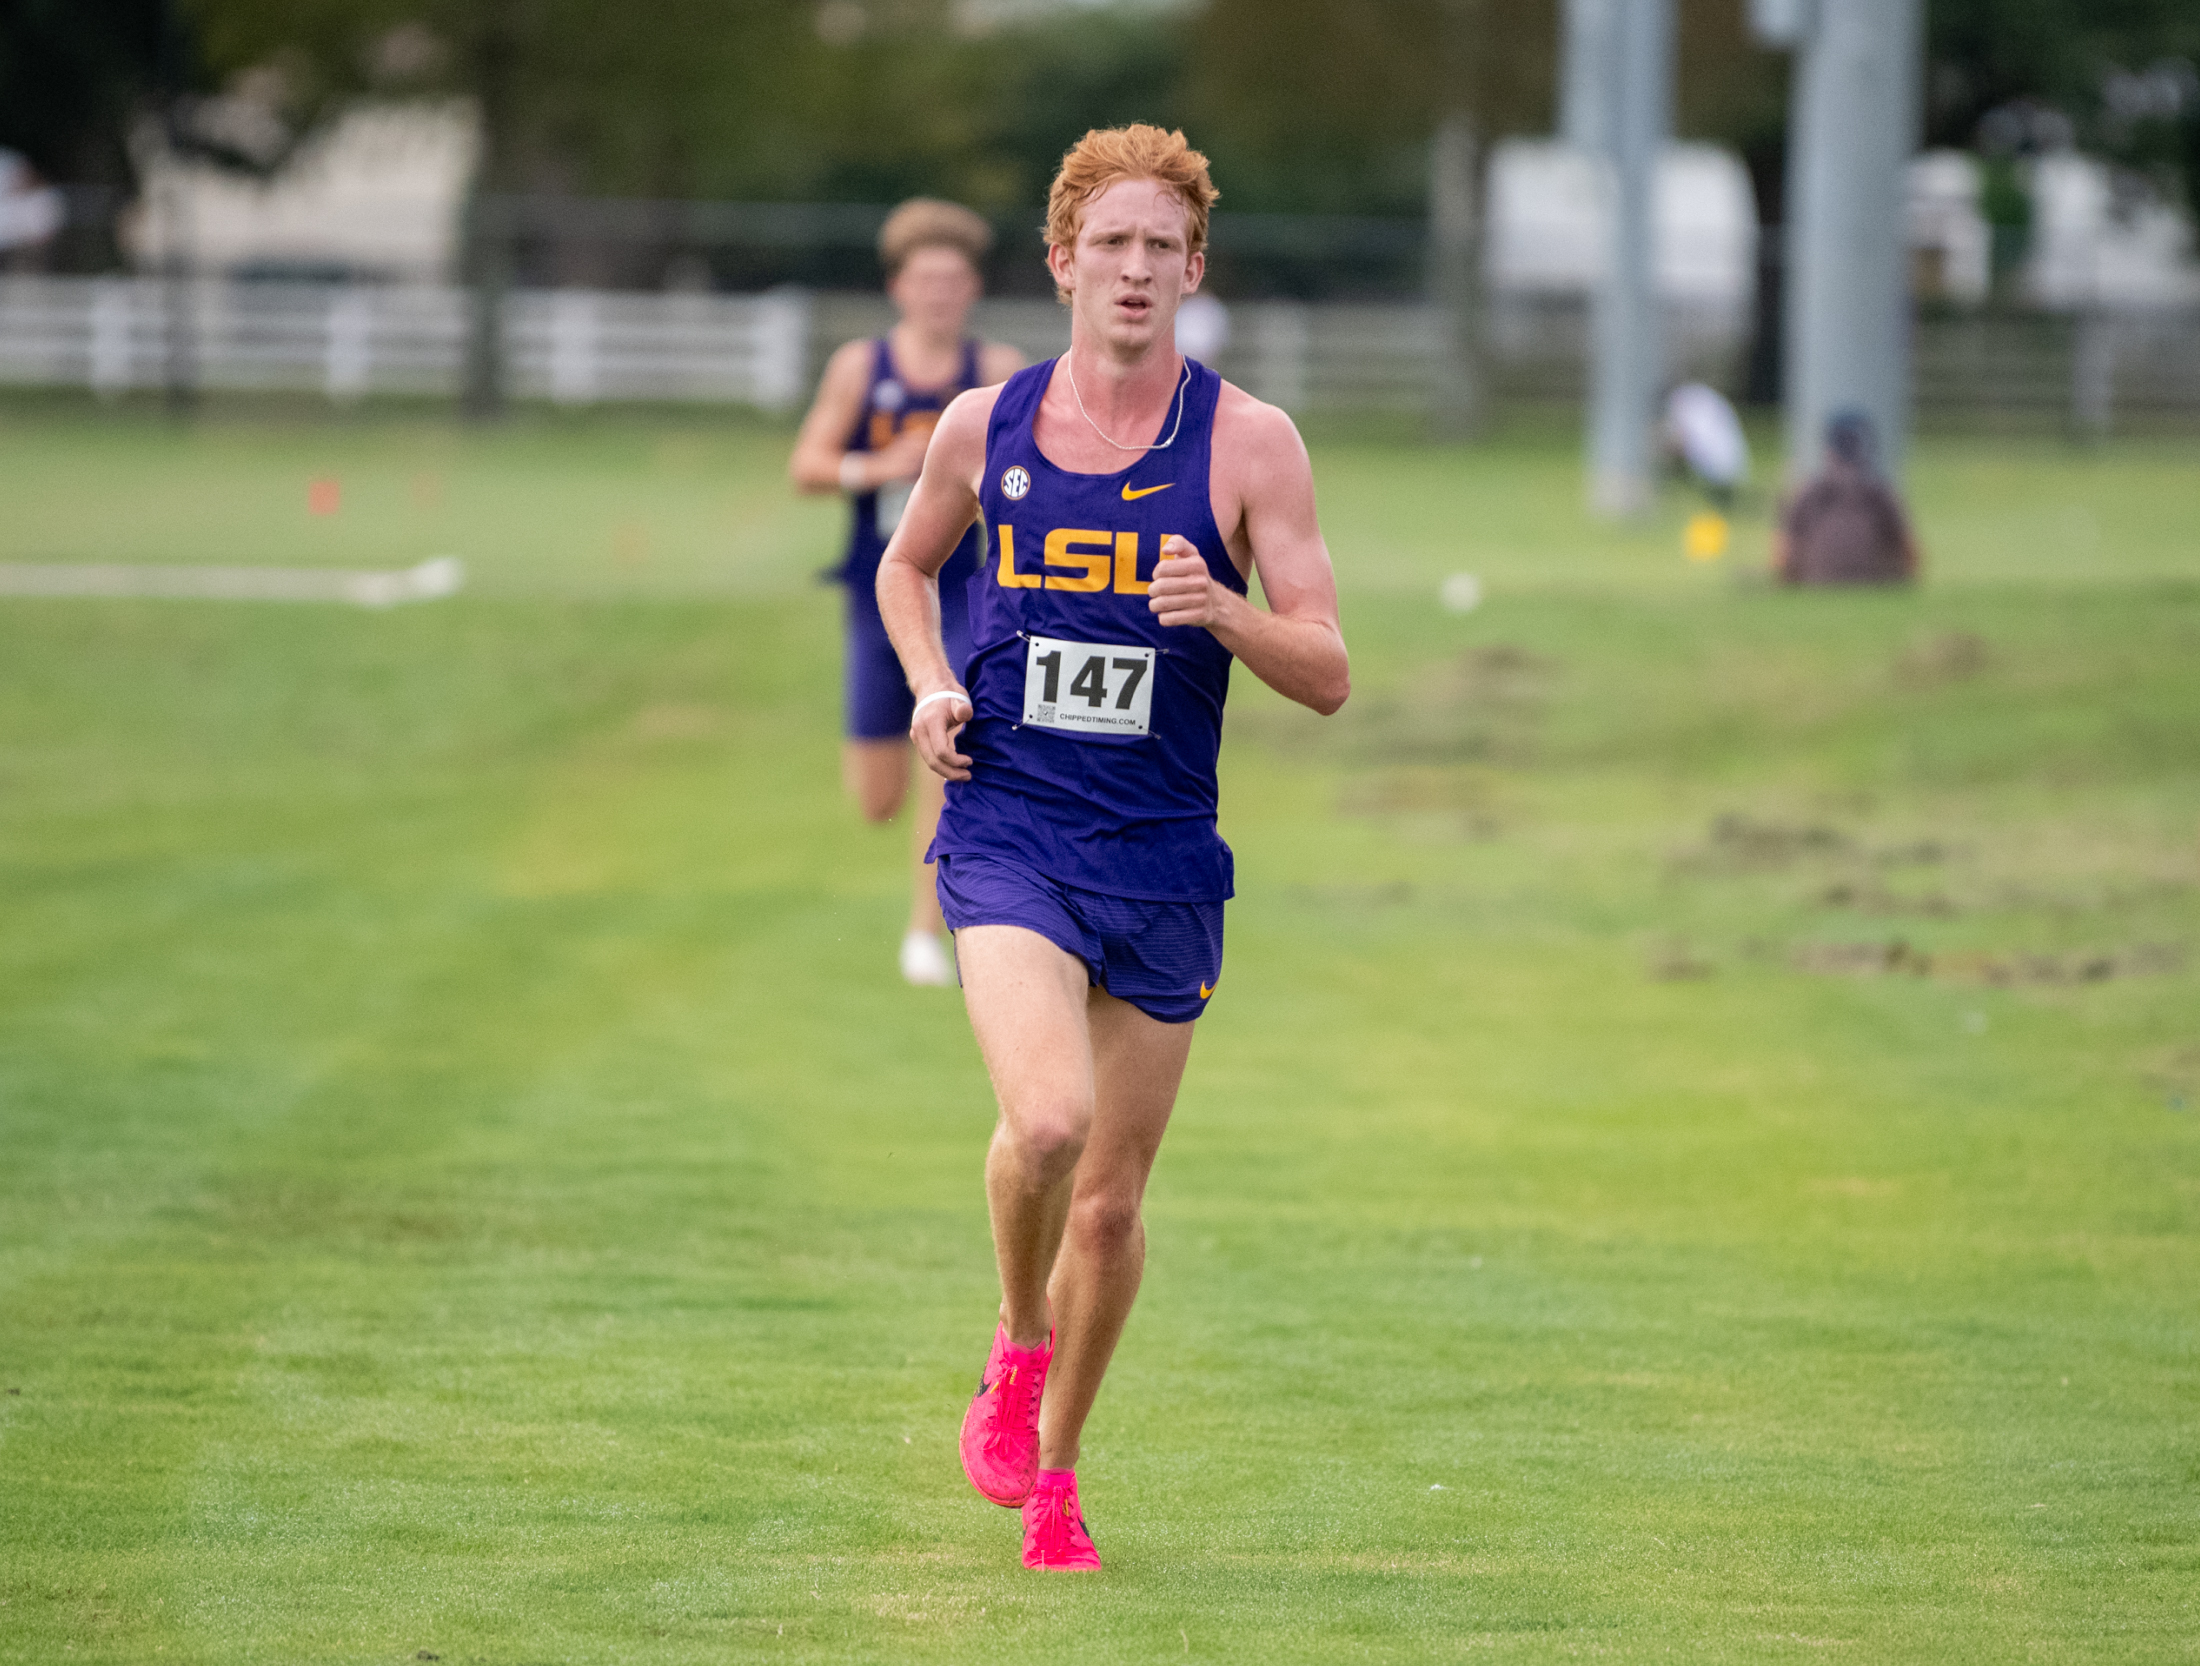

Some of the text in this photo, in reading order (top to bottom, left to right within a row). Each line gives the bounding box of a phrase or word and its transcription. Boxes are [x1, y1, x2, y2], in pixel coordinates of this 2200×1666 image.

[1003, 467, 1029, 498] SEC
[1036, 650, 1148, 710] 147
[1060, 713, 1136, 726] CHIPPEDTIMING.COM
